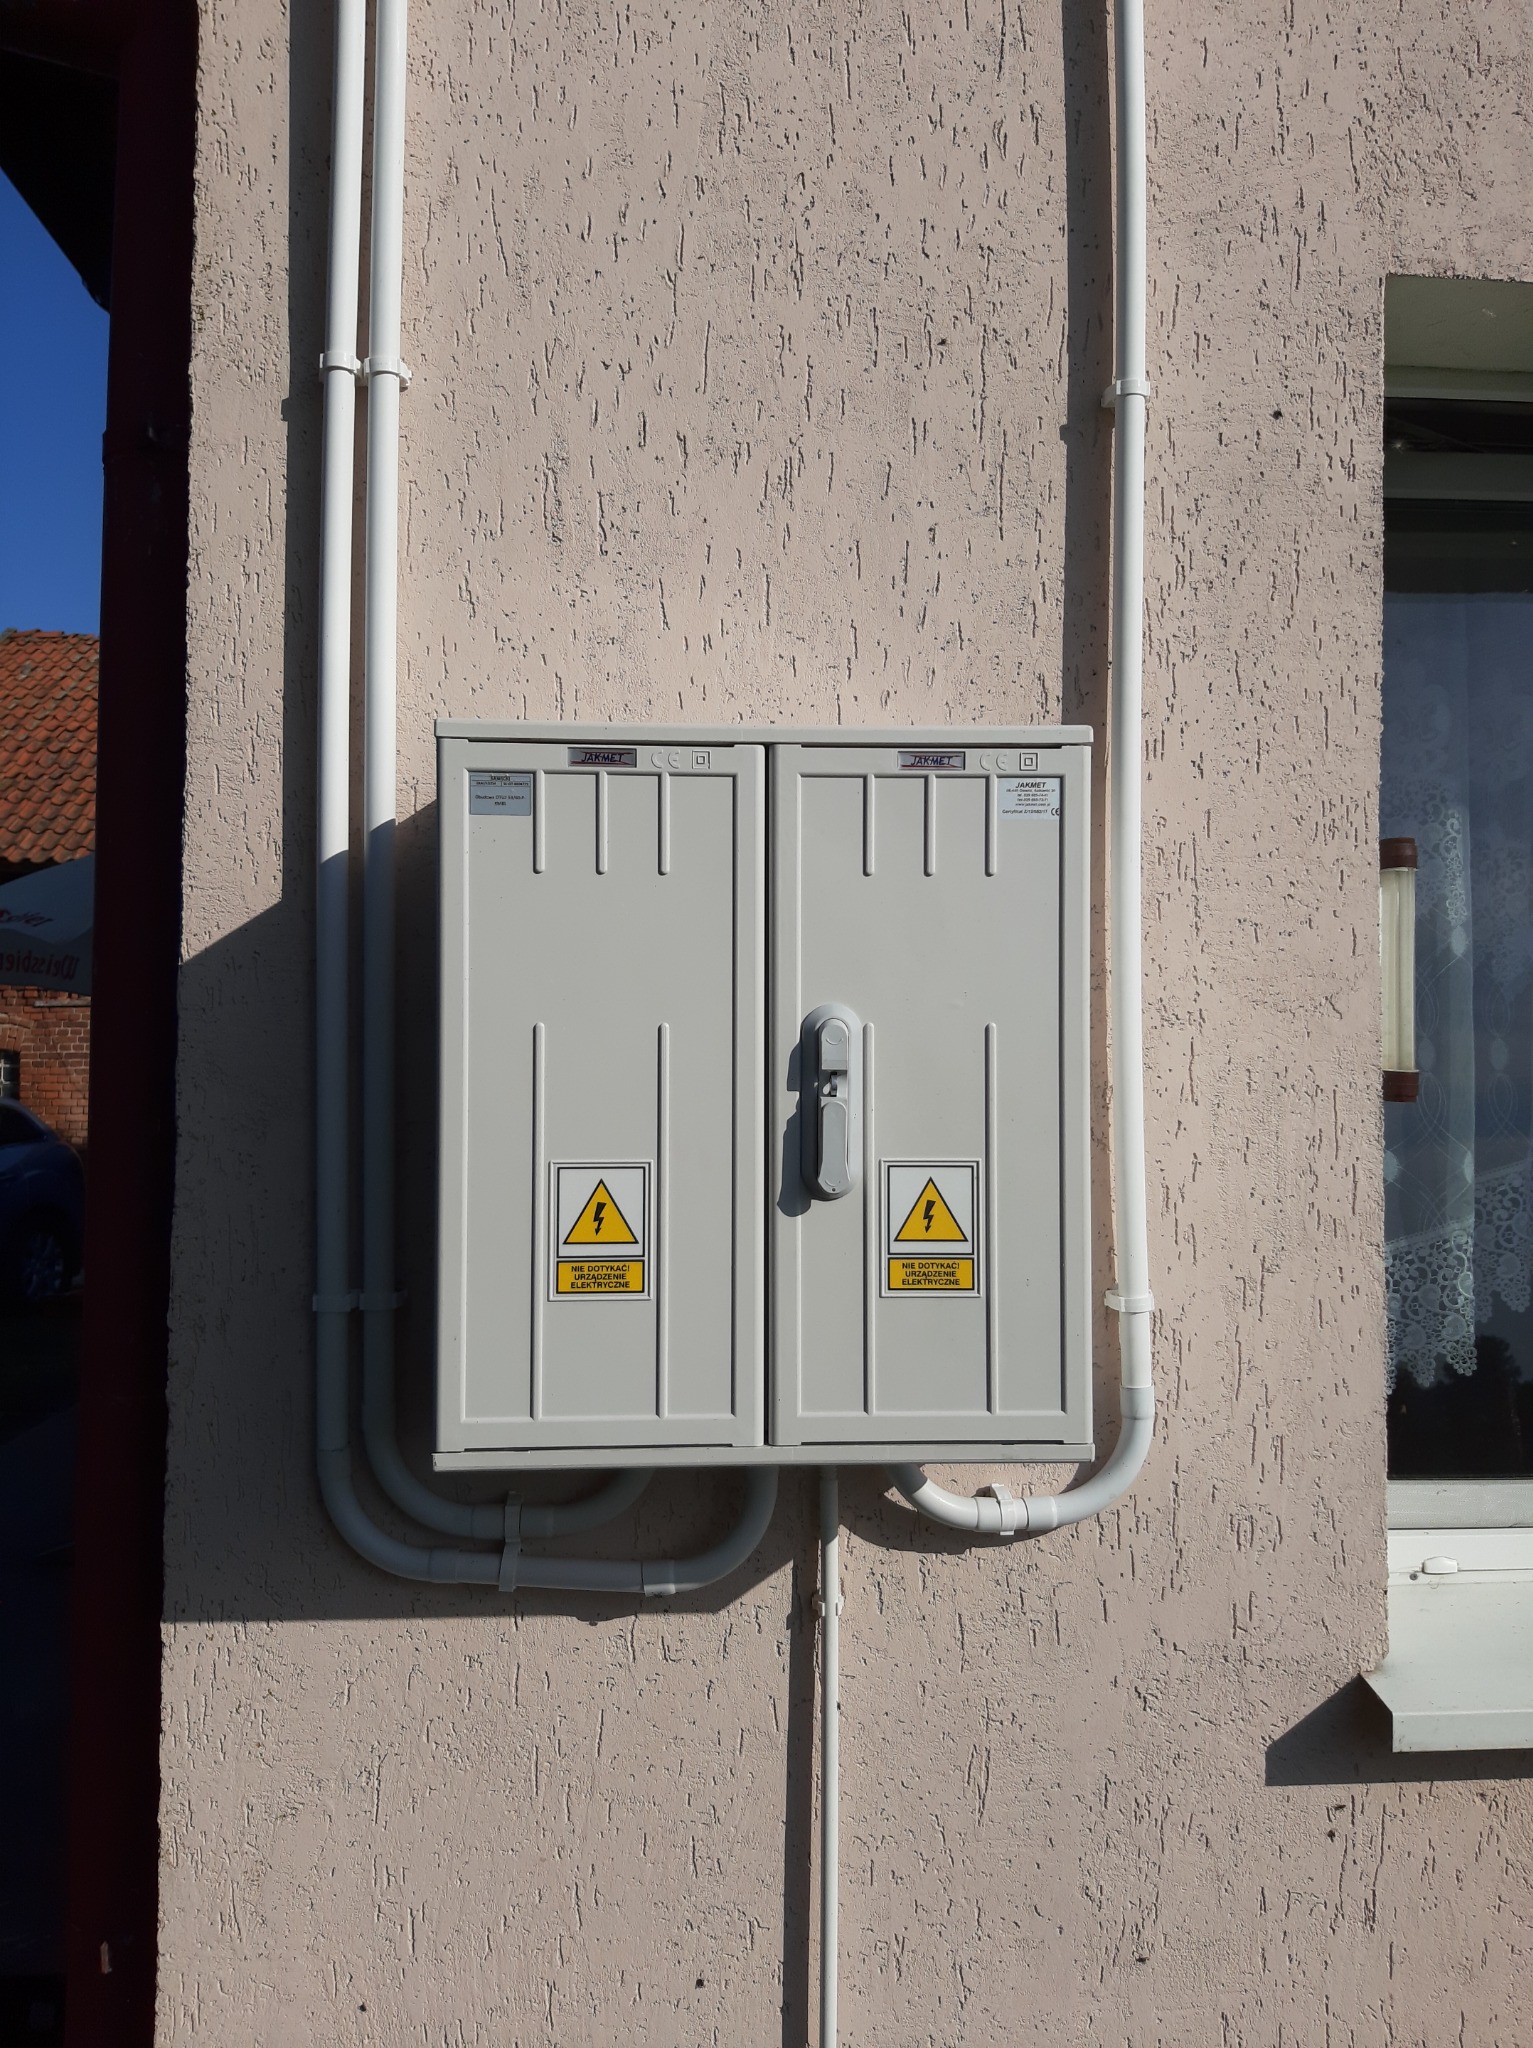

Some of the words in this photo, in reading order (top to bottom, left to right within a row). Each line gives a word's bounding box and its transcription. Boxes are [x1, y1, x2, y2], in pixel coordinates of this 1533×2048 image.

[581, 752, 625, 762] JAKMET
[911, 755, 954, 766] JAKMET
[1015, 781, 1047, 789] JAKMET
[587, 1264, 630, 1272] DOTYKAĆ!
[918, 1261, 960, 1269] DOTYKAĆ!
[574, 1273, 627, 1282] URZĄDZENIE
[905, 1270, 957, 1279] URZĄDZENIE
[570, 1281, 631, 1289] ELEKTRYCZNE
[902, 1278, 960, 1286] ELEKTRYCZNE
